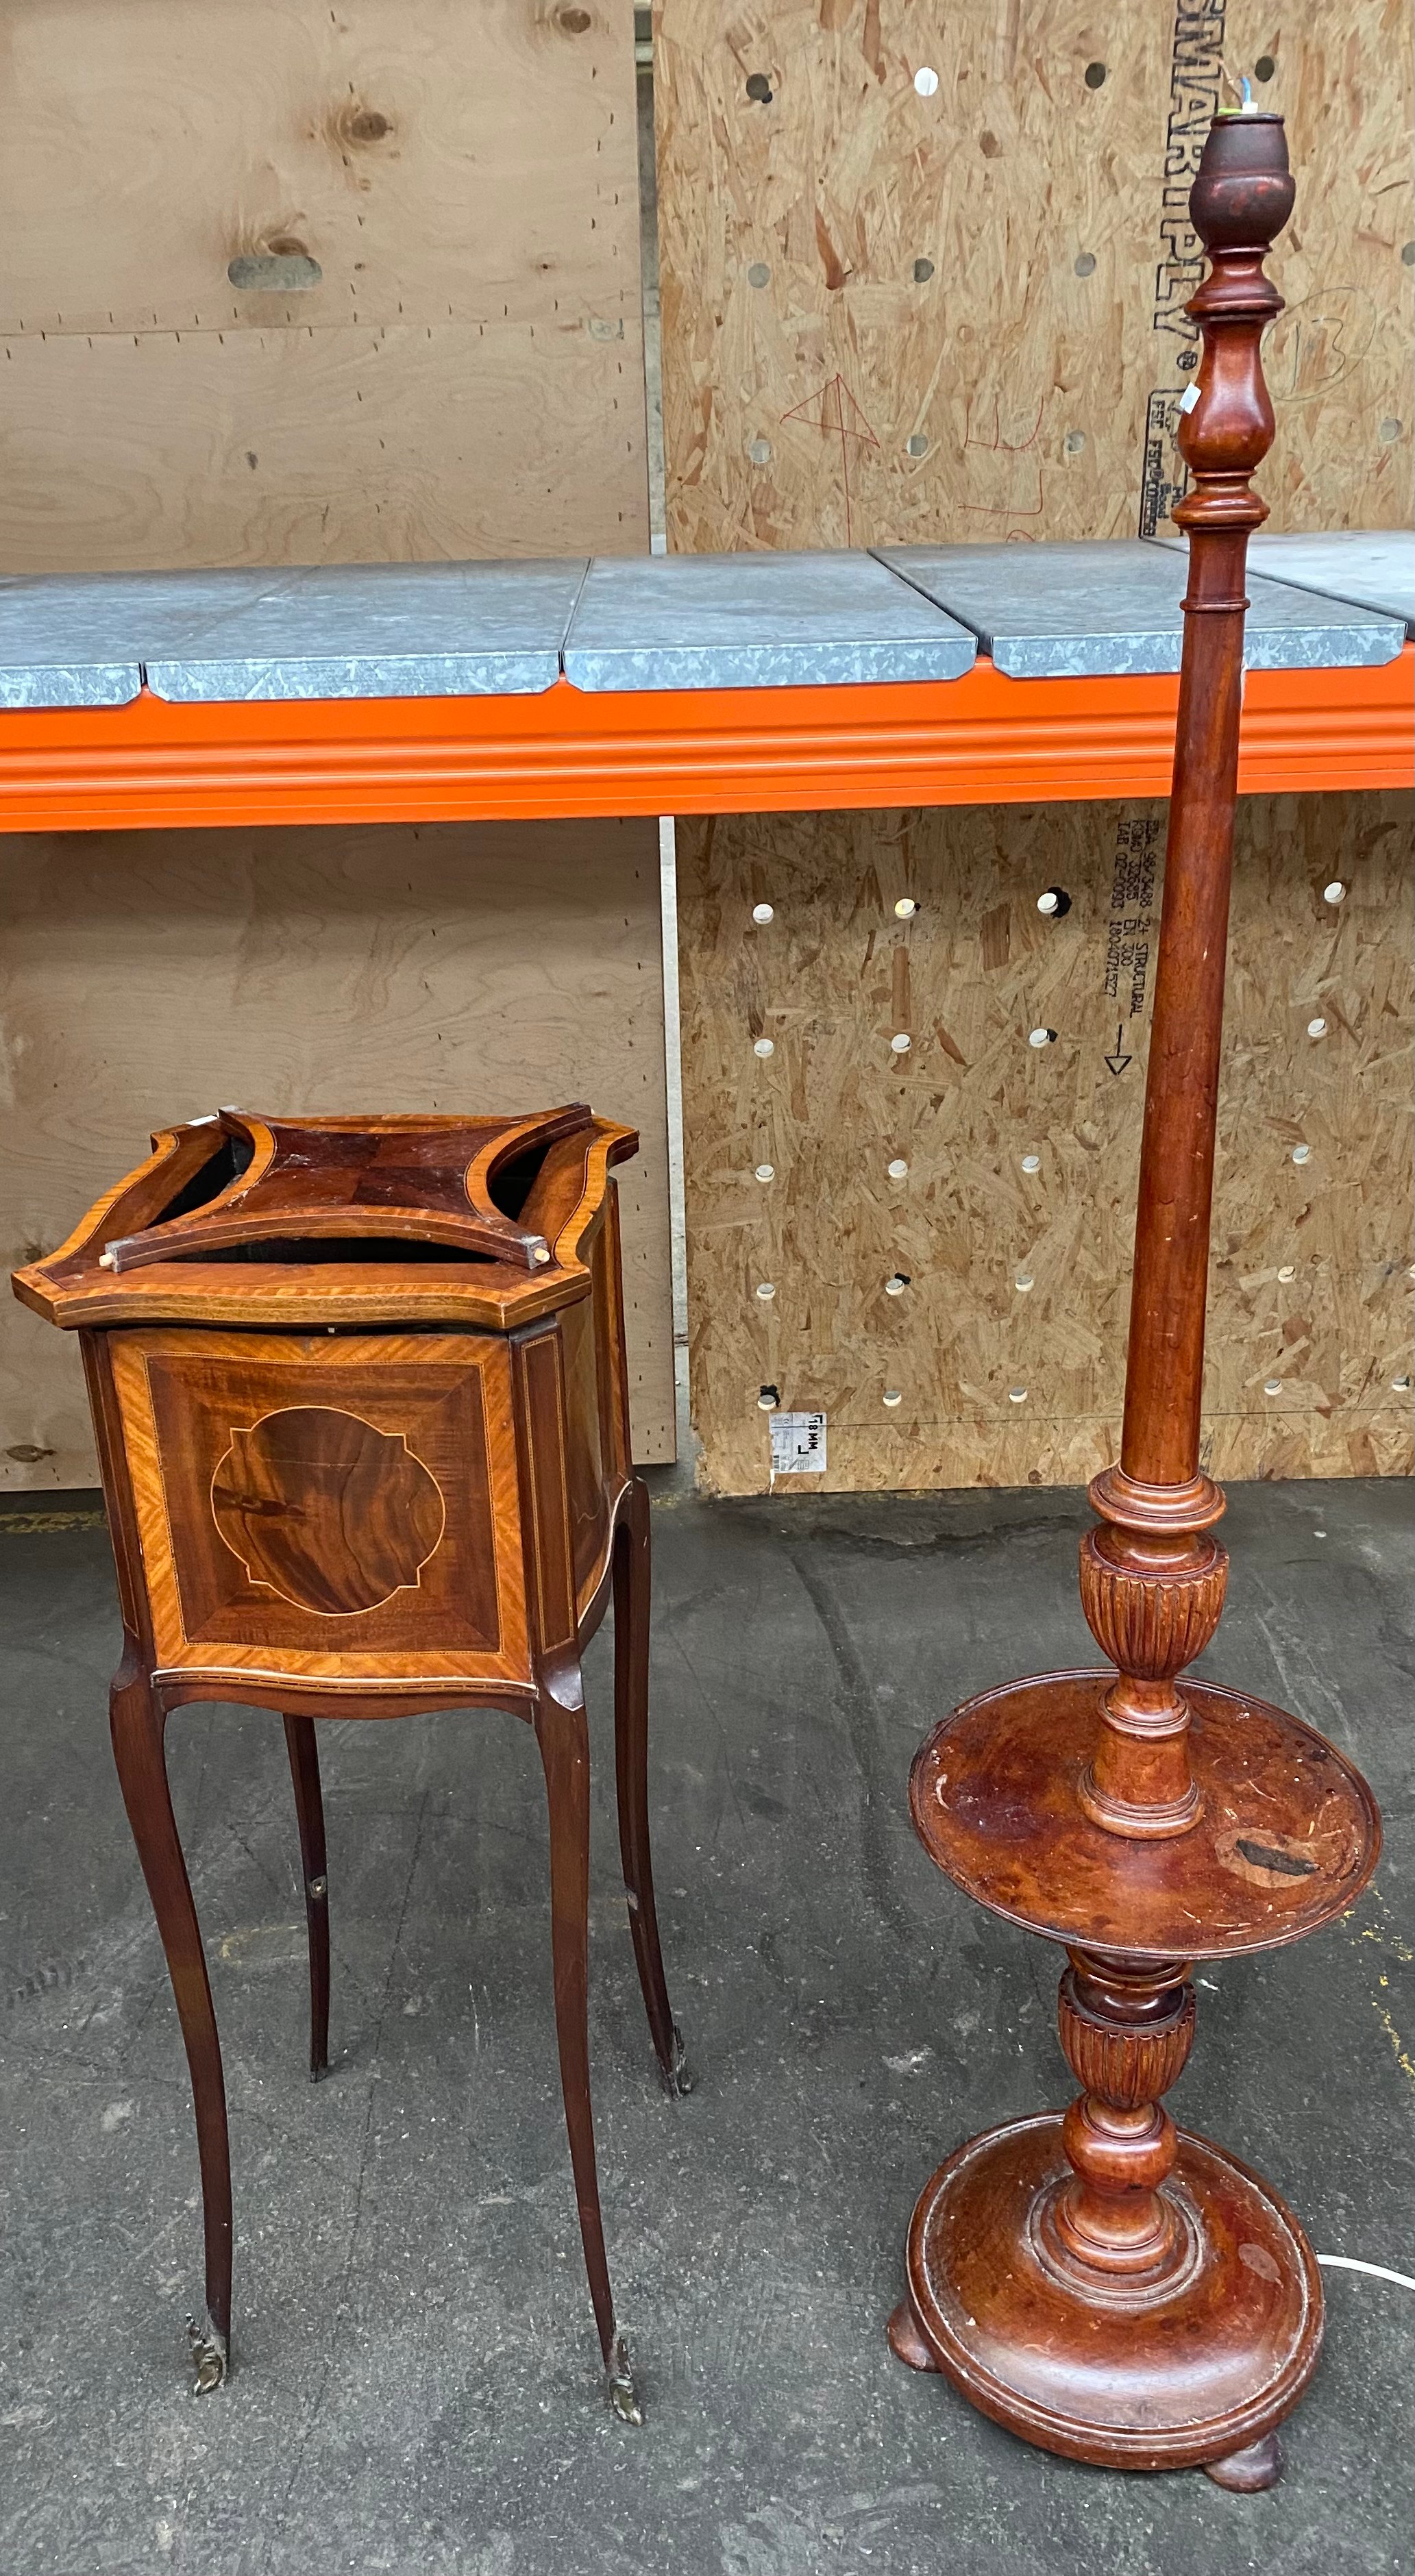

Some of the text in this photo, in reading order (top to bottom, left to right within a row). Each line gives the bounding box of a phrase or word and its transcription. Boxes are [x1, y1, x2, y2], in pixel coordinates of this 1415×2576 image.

[1123, 919, 1137, 937] EN
[1121, 943, 1135, 967] 300
[1130, 943, 1149, 1019] STRUCTURAL
[808, 1419, 818, 1450] 18 MM
